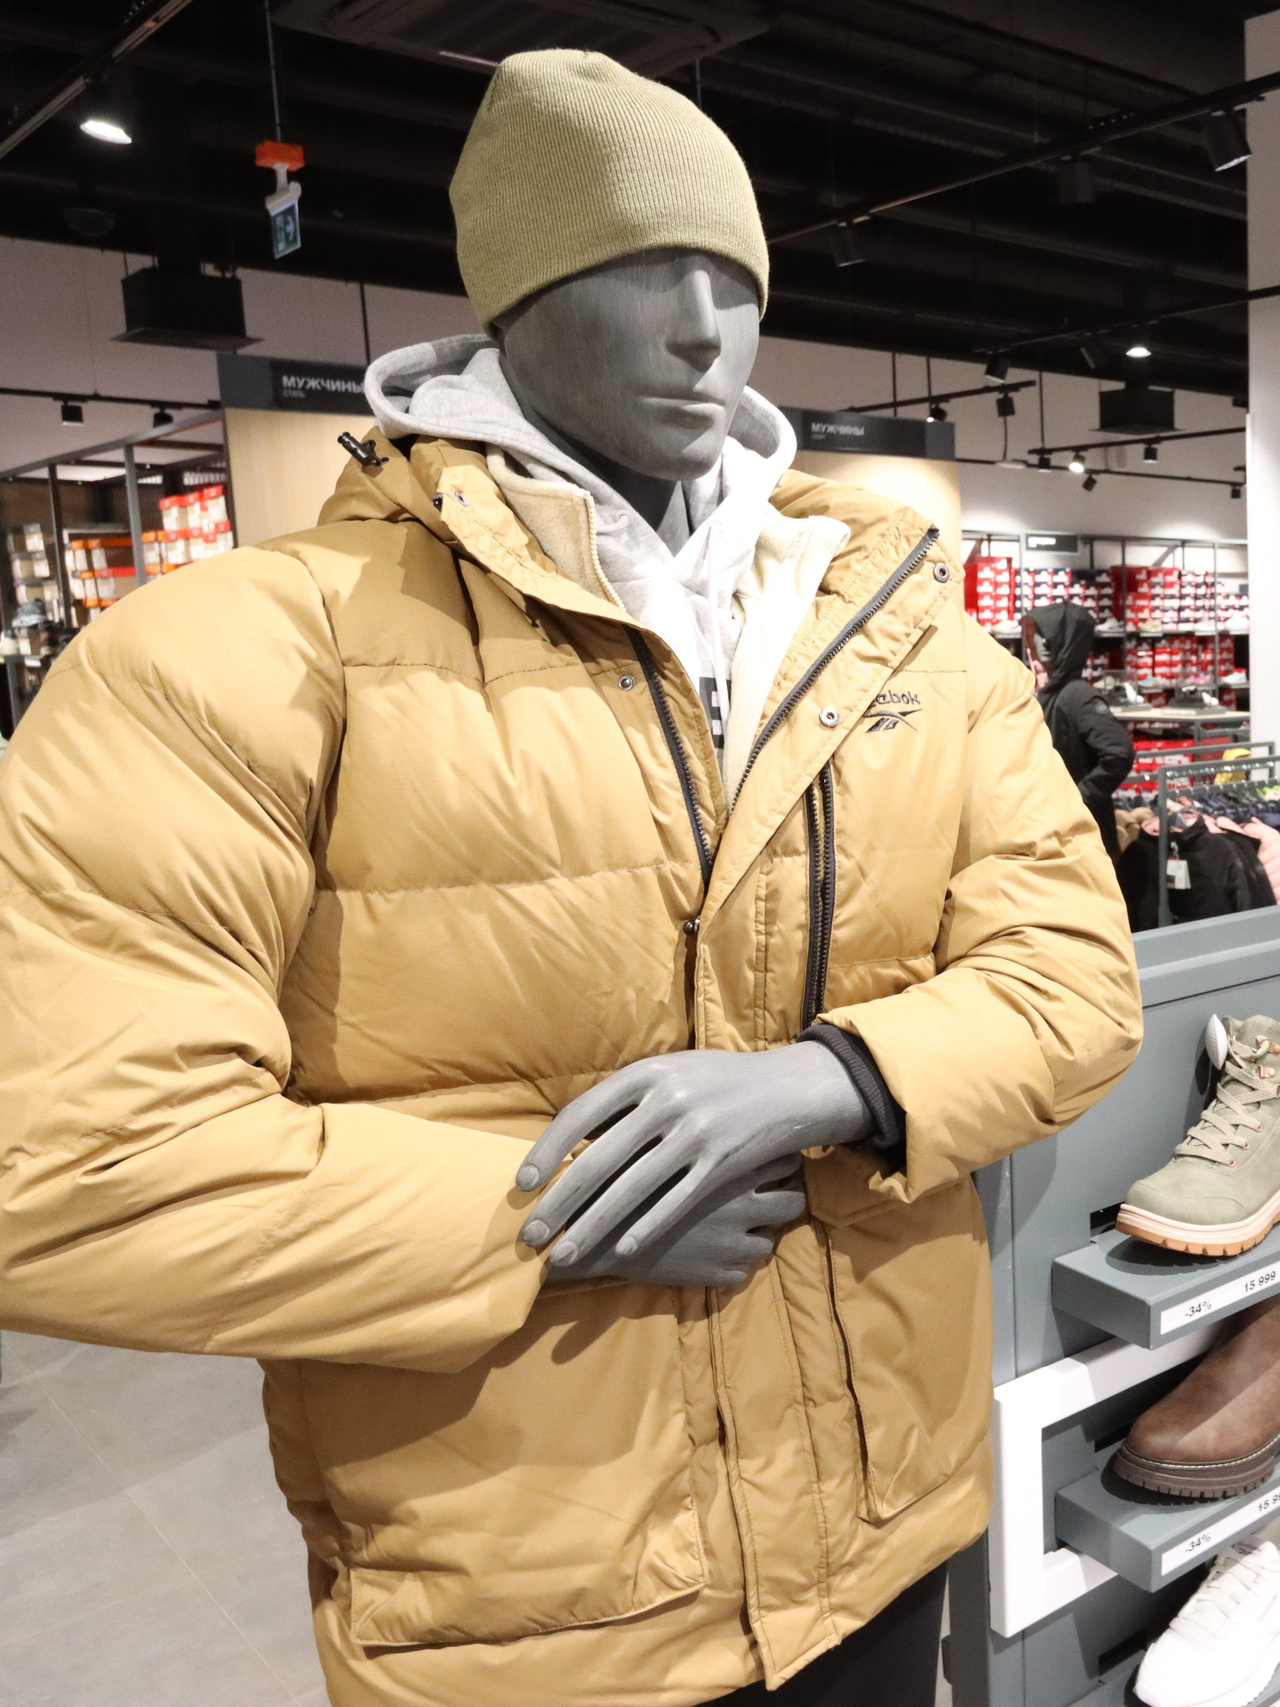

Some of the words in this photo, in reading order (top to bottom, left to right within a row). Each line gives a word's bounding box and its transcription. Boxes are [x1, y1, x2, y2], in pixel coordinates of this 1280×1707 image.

[282, 375, 365, 393] МУЖЧИНЫ
[811, 422, 865, 436] МУЖЧИНЫ
[1185, 1300, 1212, 1318] -34%
[1244, 1281, 1255, 1292] 15
[1258, 1270, 1276, 1286] 999
[1185, 1532, 1212, 1553] -34%
[1257, 1500, 1270, 1513] 15
